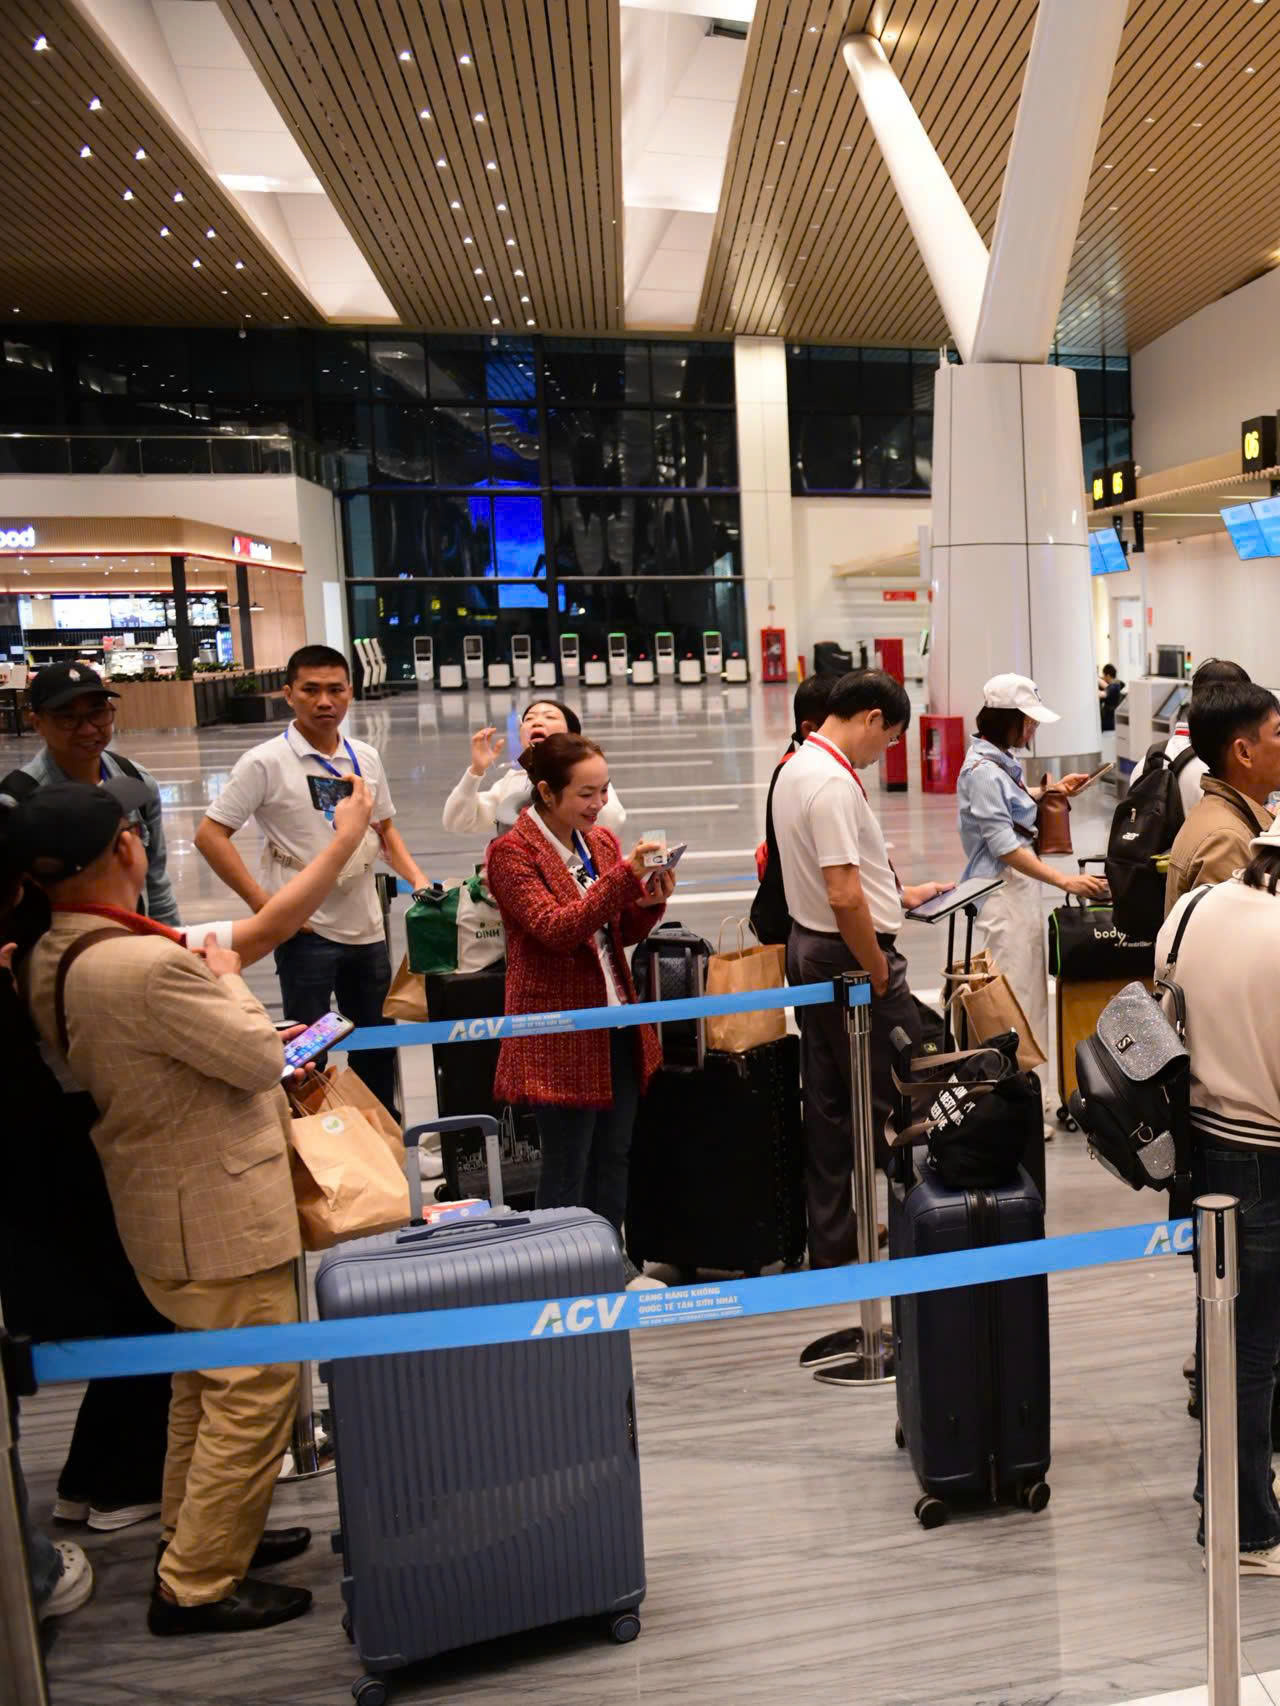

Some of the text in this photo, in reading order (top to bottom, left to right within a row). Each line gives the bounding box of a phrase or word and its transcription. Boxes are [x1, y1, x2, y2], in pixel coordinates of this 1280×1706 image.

[1244, 430, 1260, 460] 06
[1094, 927, 1126, 945] body
[448, 1018, 505, 1041] ACV
[530, 1295, 627, 1336] ACV
